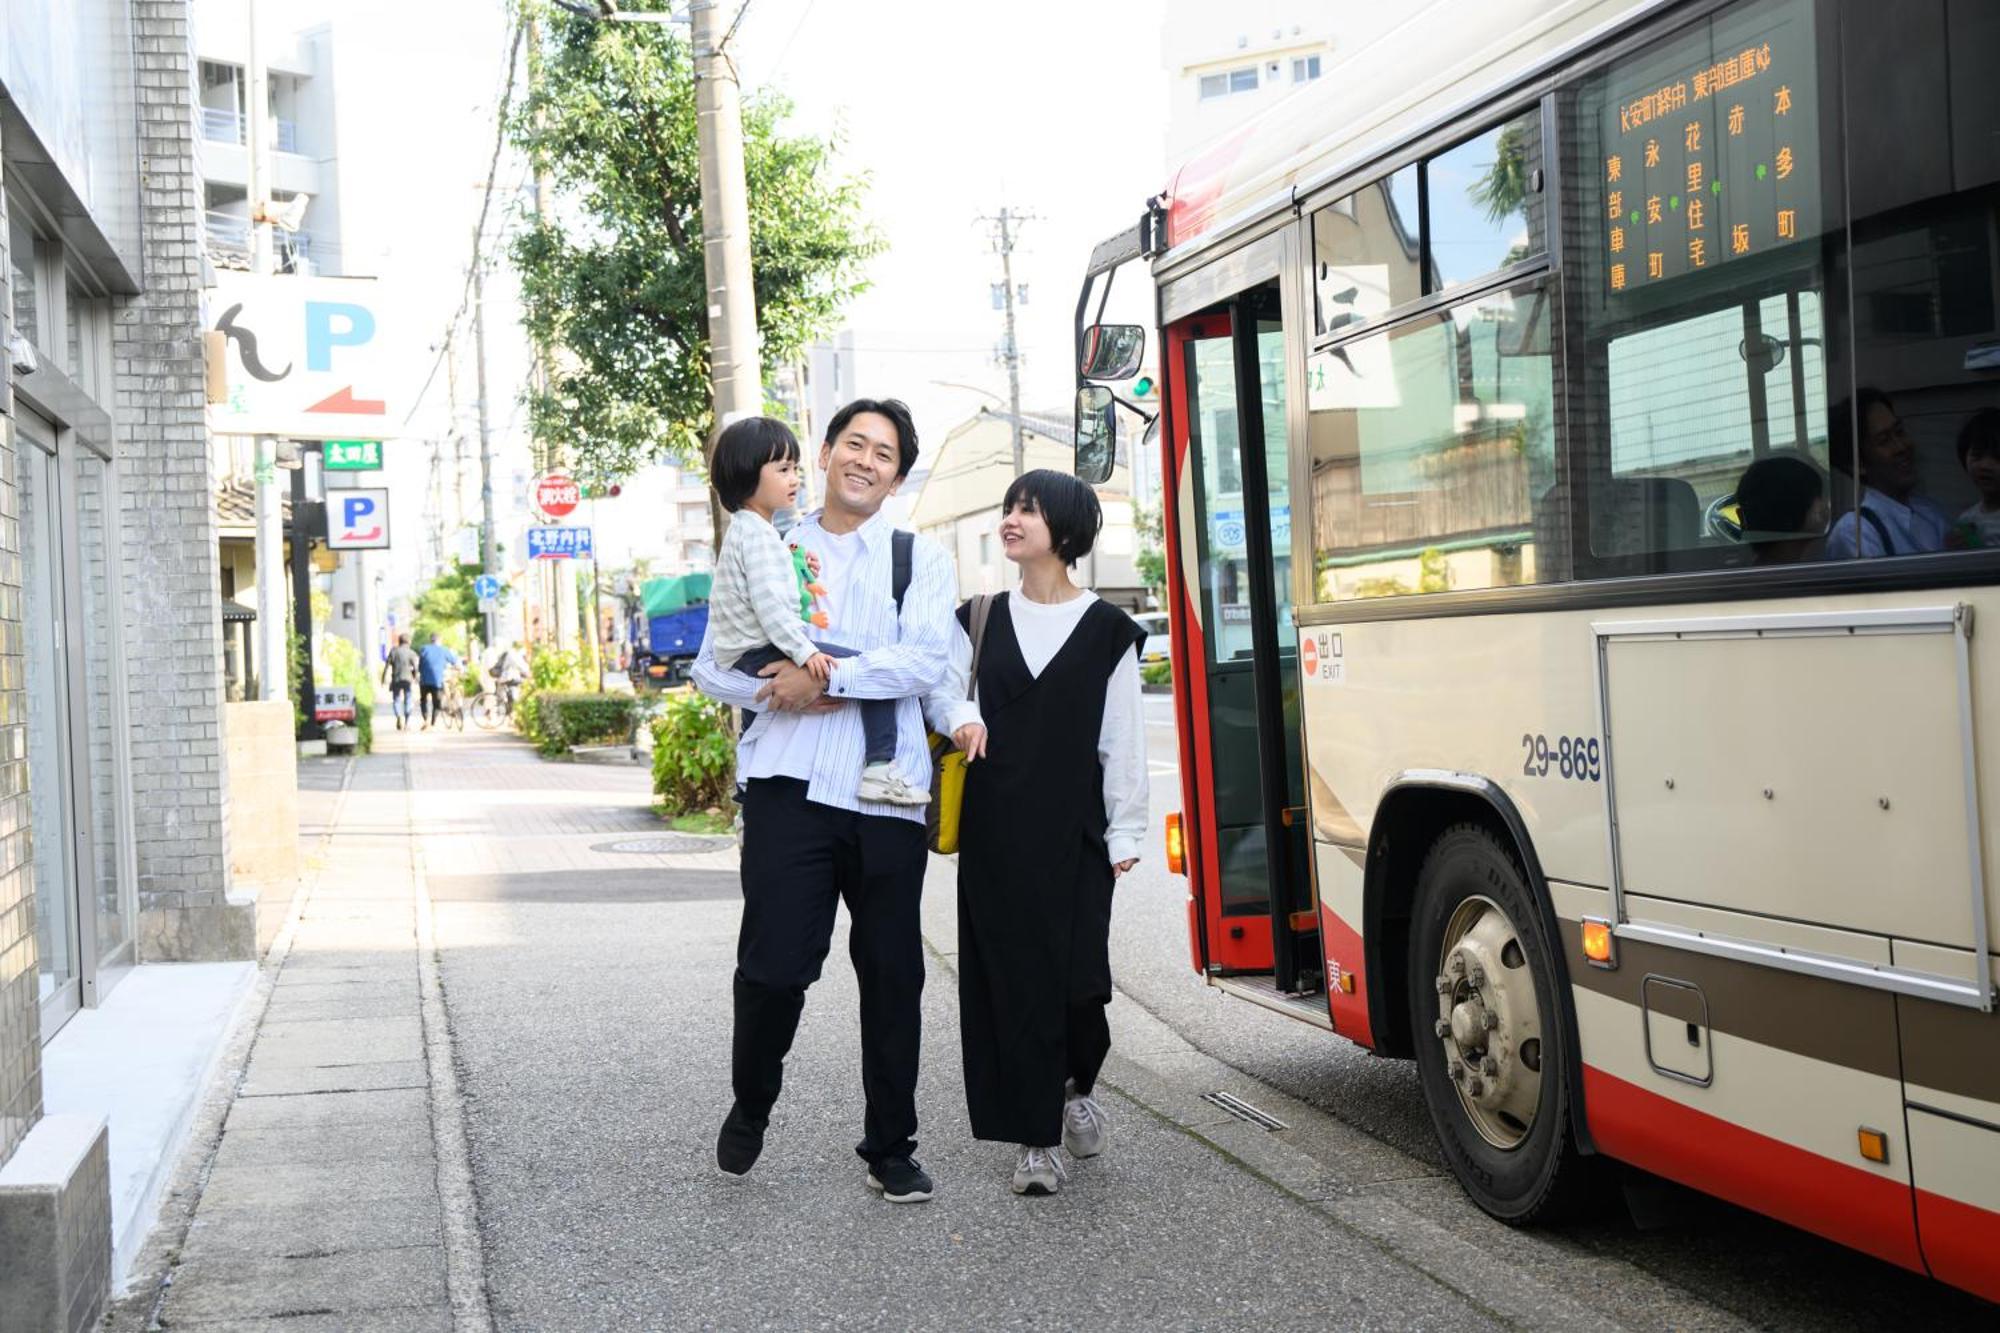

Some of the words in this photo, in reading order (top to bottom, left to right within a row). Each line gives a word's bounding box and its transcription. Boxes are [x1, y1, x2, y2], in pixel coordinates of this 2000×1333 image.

[1685, 121, 1705, 266] 花里住宅
[1728, 105, 1750, 254] 赤坂
[1774, 85, 1795, 238] 本多町
[1607, 156, 1626, 290] 東部車庫
[1645, 139, 1664, 278] 永安町
[305, 301, 376, 372] P
[344, 498, 375, 528] P
[1318, 633, 1343, 659] 出口
[1322, 664, 1341, 679] EXIT
[1522, 733, 1600, 782] 29-869
[1327, 958, 1343, 993] 東
